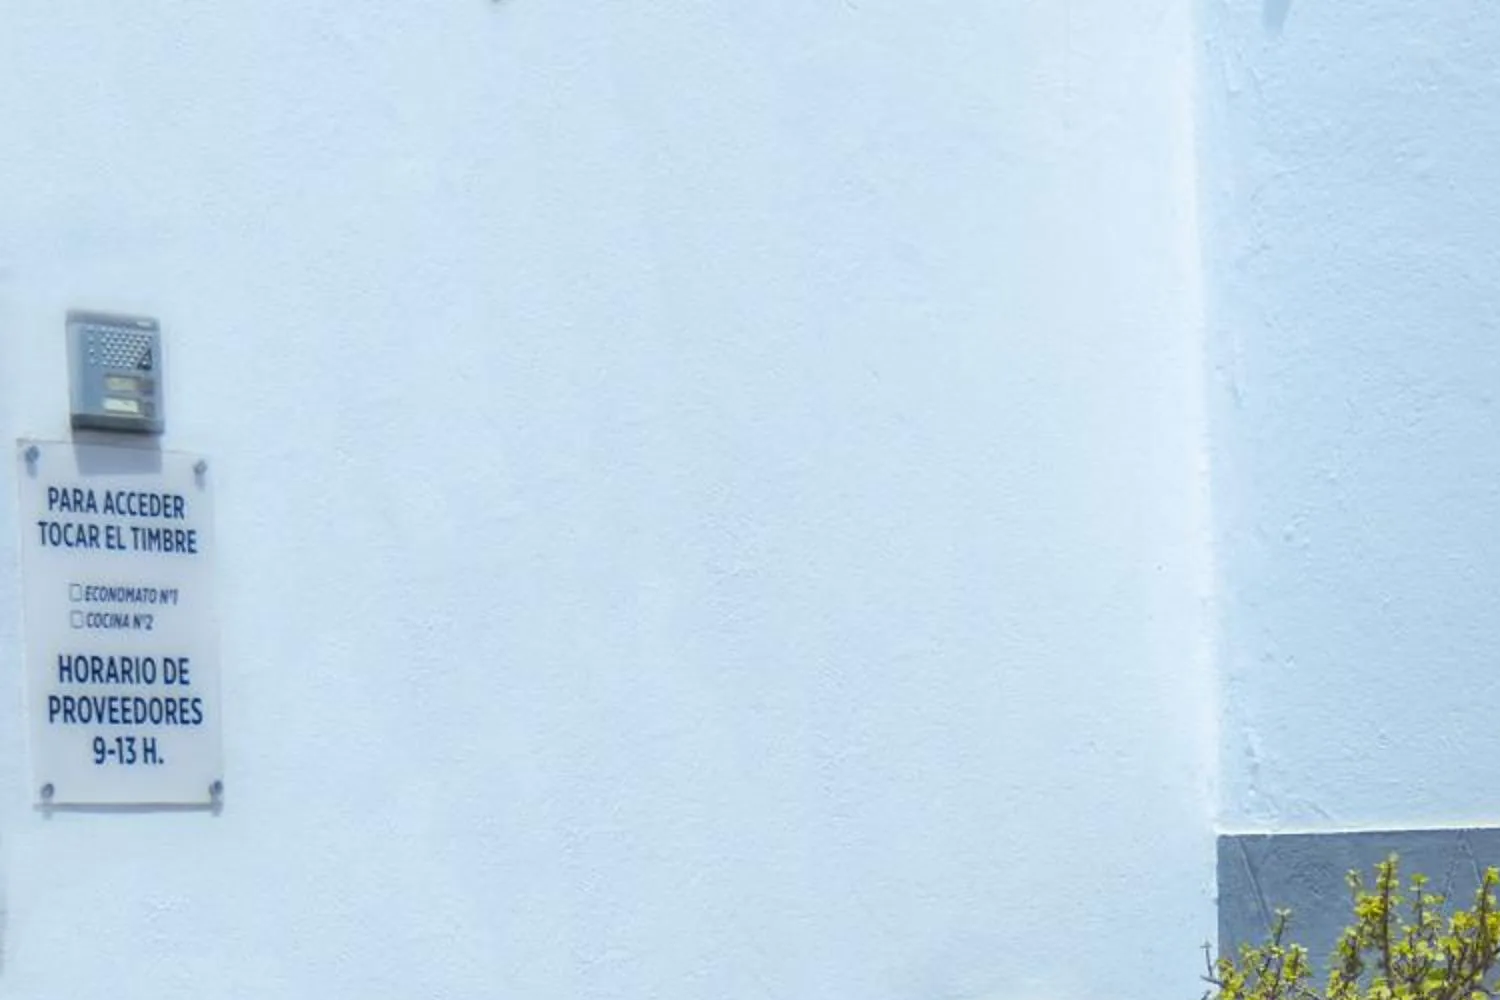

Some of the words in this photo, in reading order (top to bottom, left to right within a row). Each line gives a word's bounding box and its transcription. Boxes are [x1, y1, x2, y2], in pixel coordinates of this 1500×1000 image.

[47, 486, 98, 514] PARA
[103, 490, 185, 519] ACCEDER
[37, 520, 100, 548] TOCAR
[105, 525, 126, 550] EL
[130, 526, 198, 554] TIMBRE
[85, 585, 158, 604] ECONOMATO
[86, 612, 130, 629] COCINA
[58, 654, 157, 685] HORARIO
[163, 657, 191, 686] DE
[48, 695, 204, 726] PROVEEDORES
[93, 736, 137, 765] 9-13
[142, 737, 164, 765] H.
